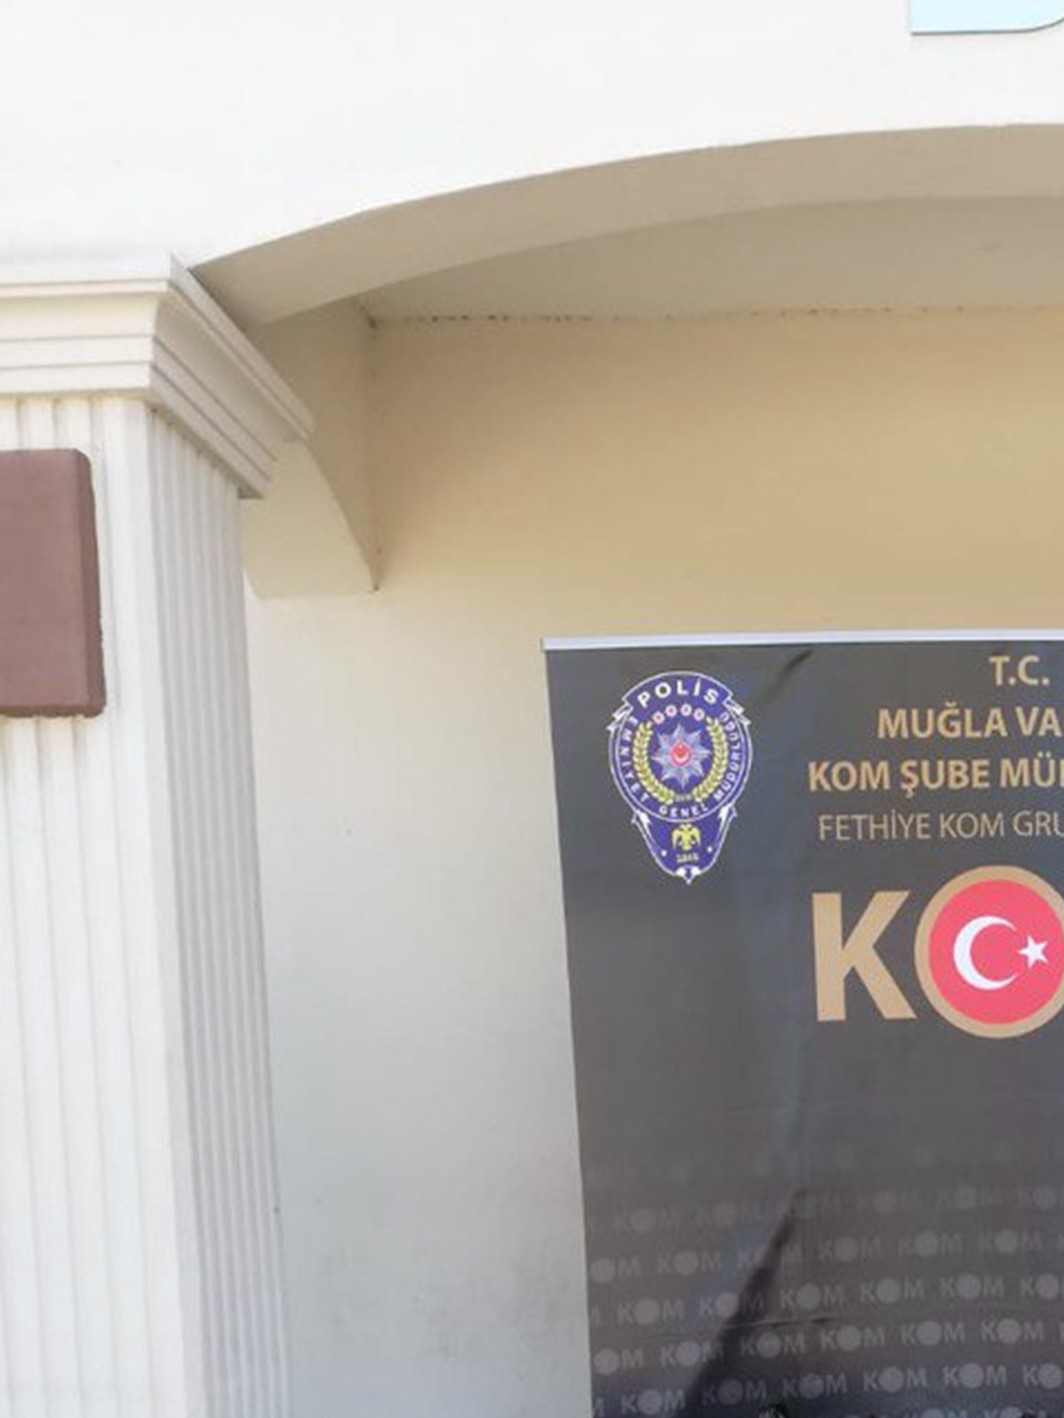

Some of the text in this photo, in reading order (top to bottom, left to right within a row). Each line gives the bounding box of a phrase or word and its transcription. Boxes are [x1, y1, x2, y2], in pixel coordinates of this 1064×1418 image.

[989, 655, 1050, 686] T.C.
[636, 679, 719, 708] POLİS
[877, 702, 1008, 739] MUĞLA
[808, 760, 890, 792] KOM
[900, 759, 990, 798] ŞUBE
[818, 808, 931, 841] FETHİYE
[939, 813, 1005, 839] KOM
